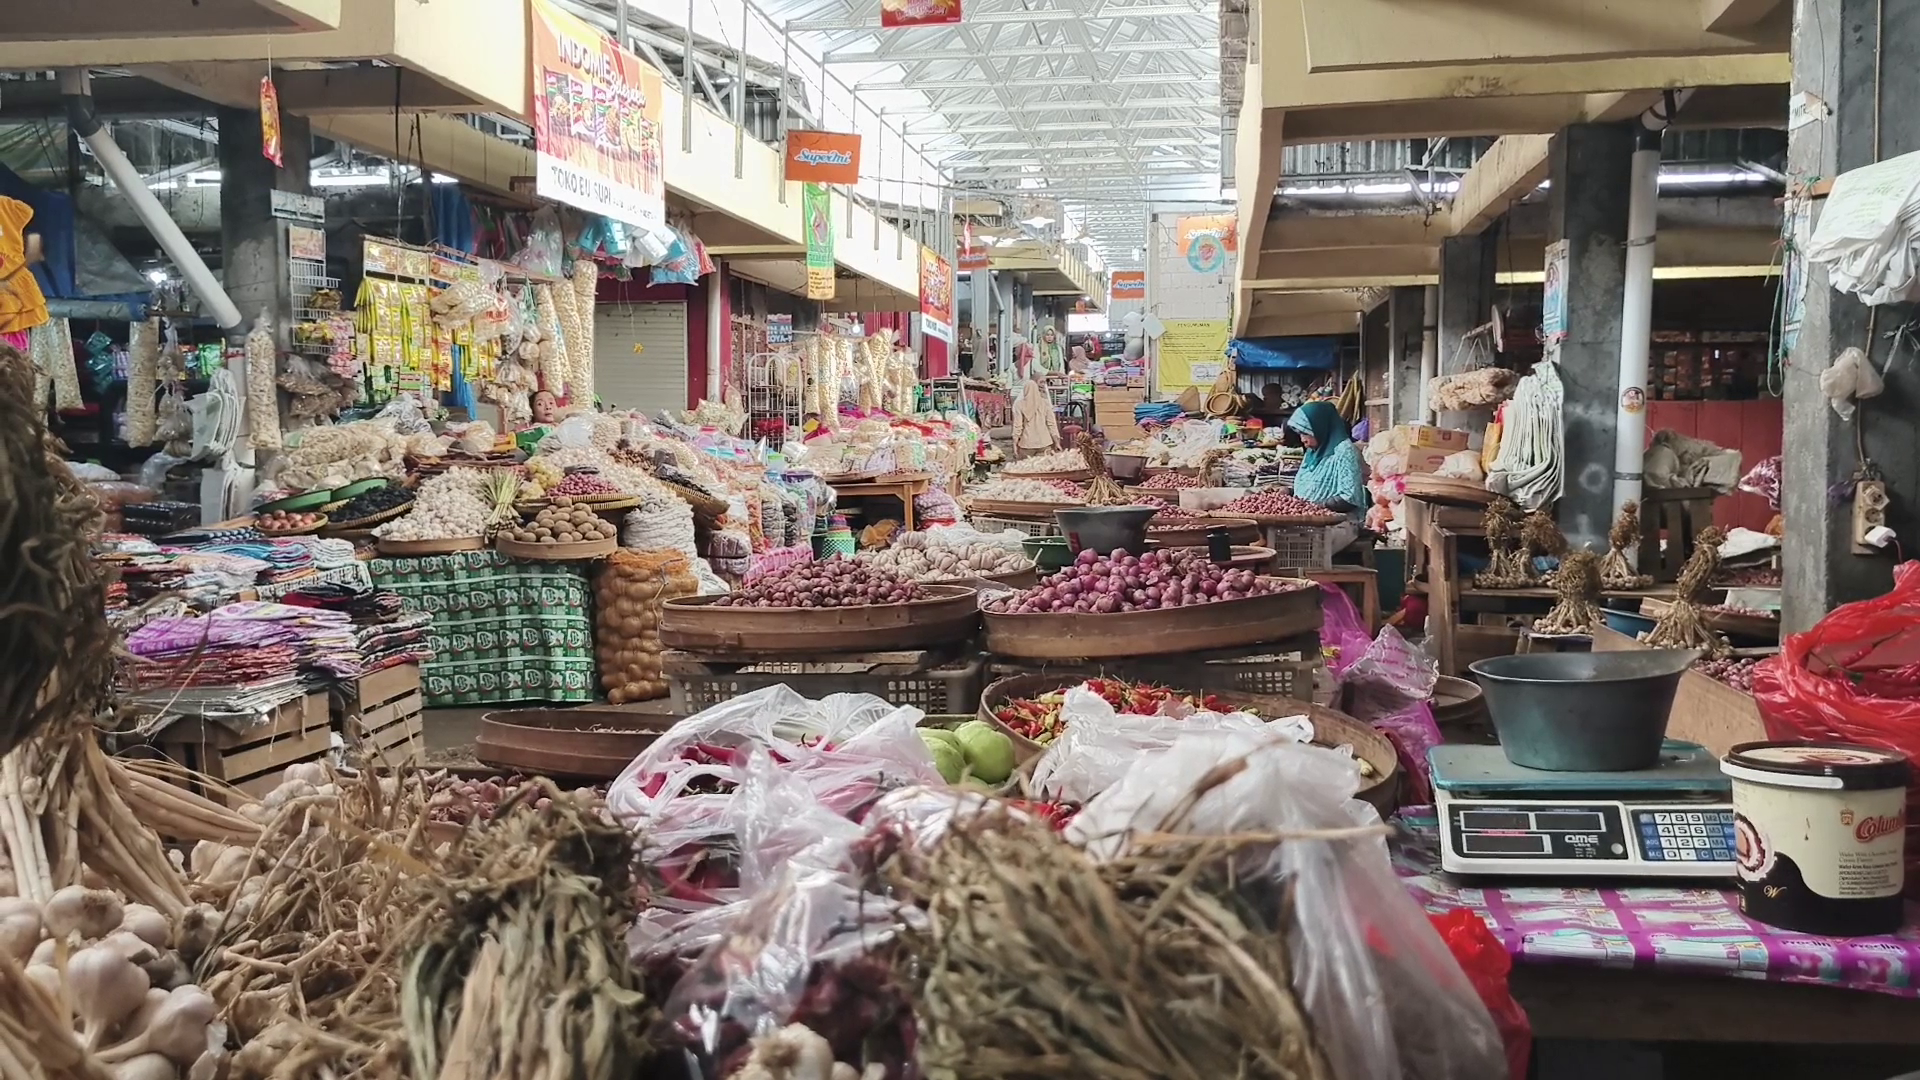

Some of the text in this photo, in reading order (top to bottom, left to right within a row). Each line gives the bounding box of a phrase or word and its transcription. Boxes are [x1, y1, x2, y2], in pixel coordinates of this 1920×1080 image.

[557, 32, 612, 85] INDOMIE
[551, 166, 577, 194] TOKO
[1658, 814, 1667, 822] 7
[1675, 814, 1685, 822] 8
[1691, 814, 1701, 822] 9
[1661, 826, 1671, 834] 4
[1678, 826, 1688, 834] 5
[1694, 826, 1704, 834] 6
[1680, 839, 1691, 847] 2
[1697, 839, 1707, 847] 3
[1666, 850, 1677, 858] 0
[1701, 850, 1709, 858] C
